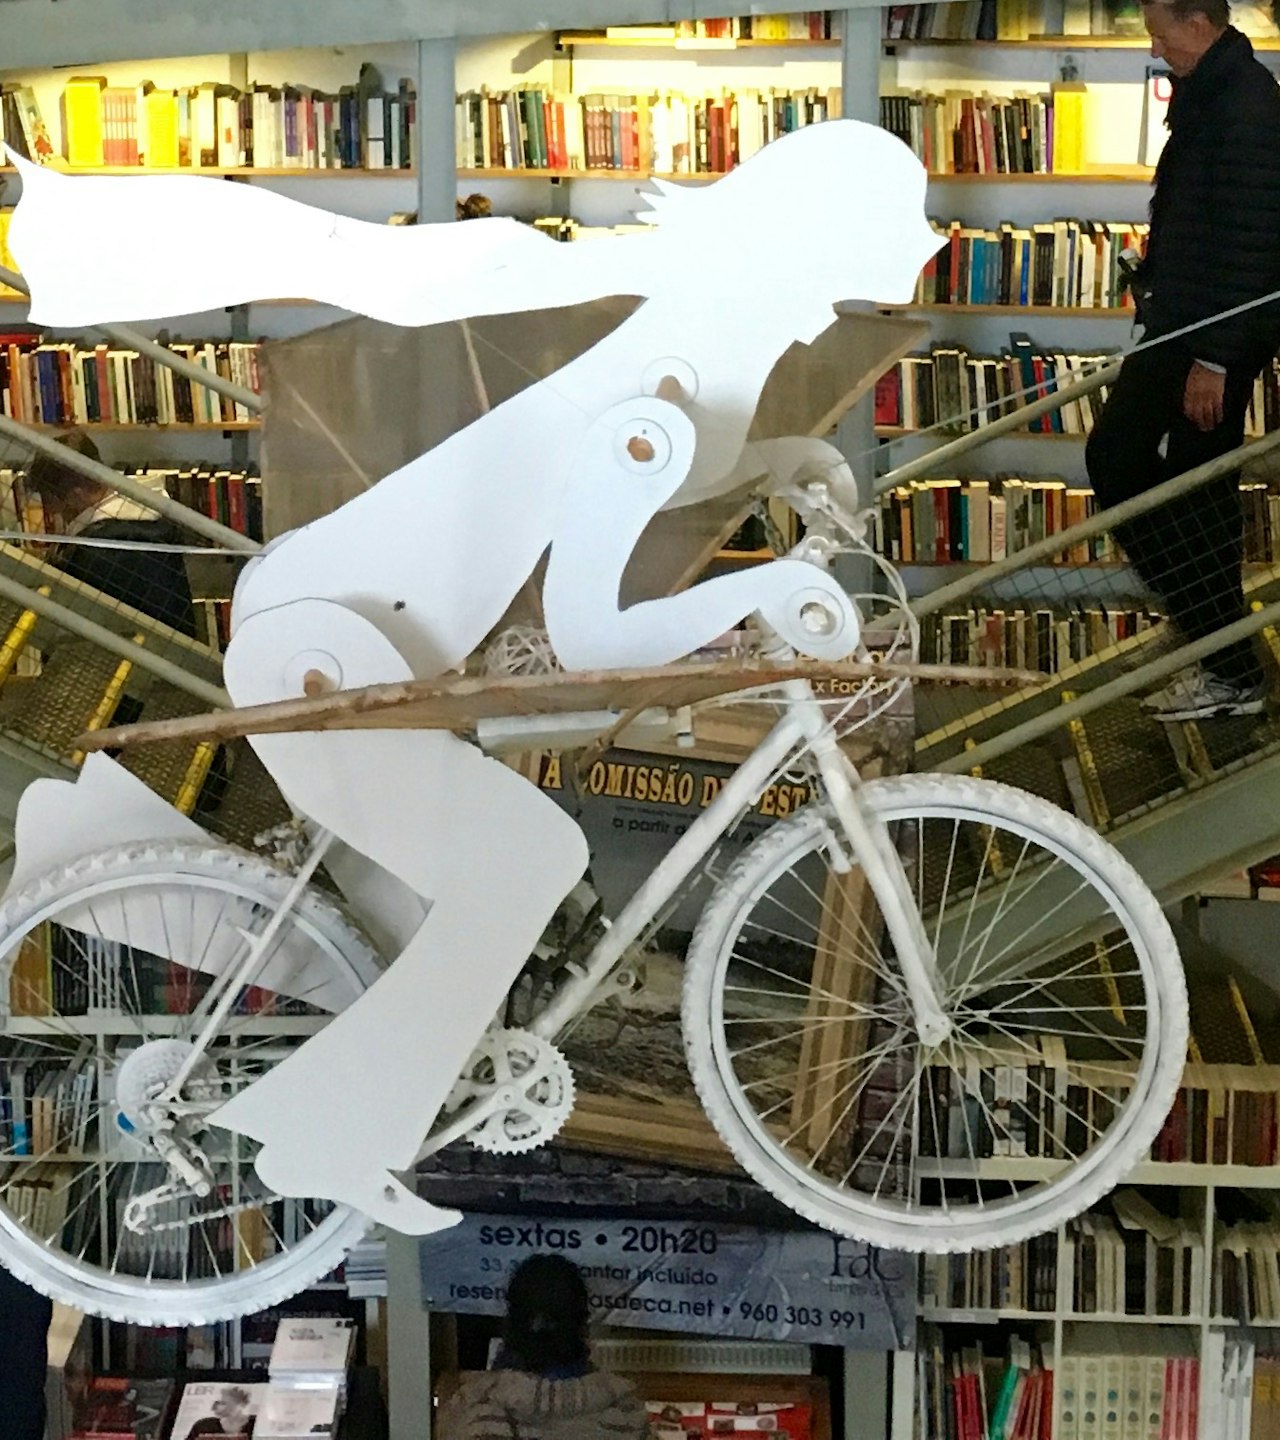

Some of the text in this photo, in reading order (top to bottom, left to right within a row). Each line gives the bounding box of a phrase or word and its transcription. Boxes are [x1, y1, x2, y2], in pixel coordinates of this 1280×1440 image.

[541, 757, 562, 790] A
[584, 760, 694, 808] OMISSÃO
[479, 1222, 718, 1255] sextas 20h20
[579, 1265, 632, 1281] antar
[449, 1282, 866, 1330] reser asdeca.net 960 303 991
